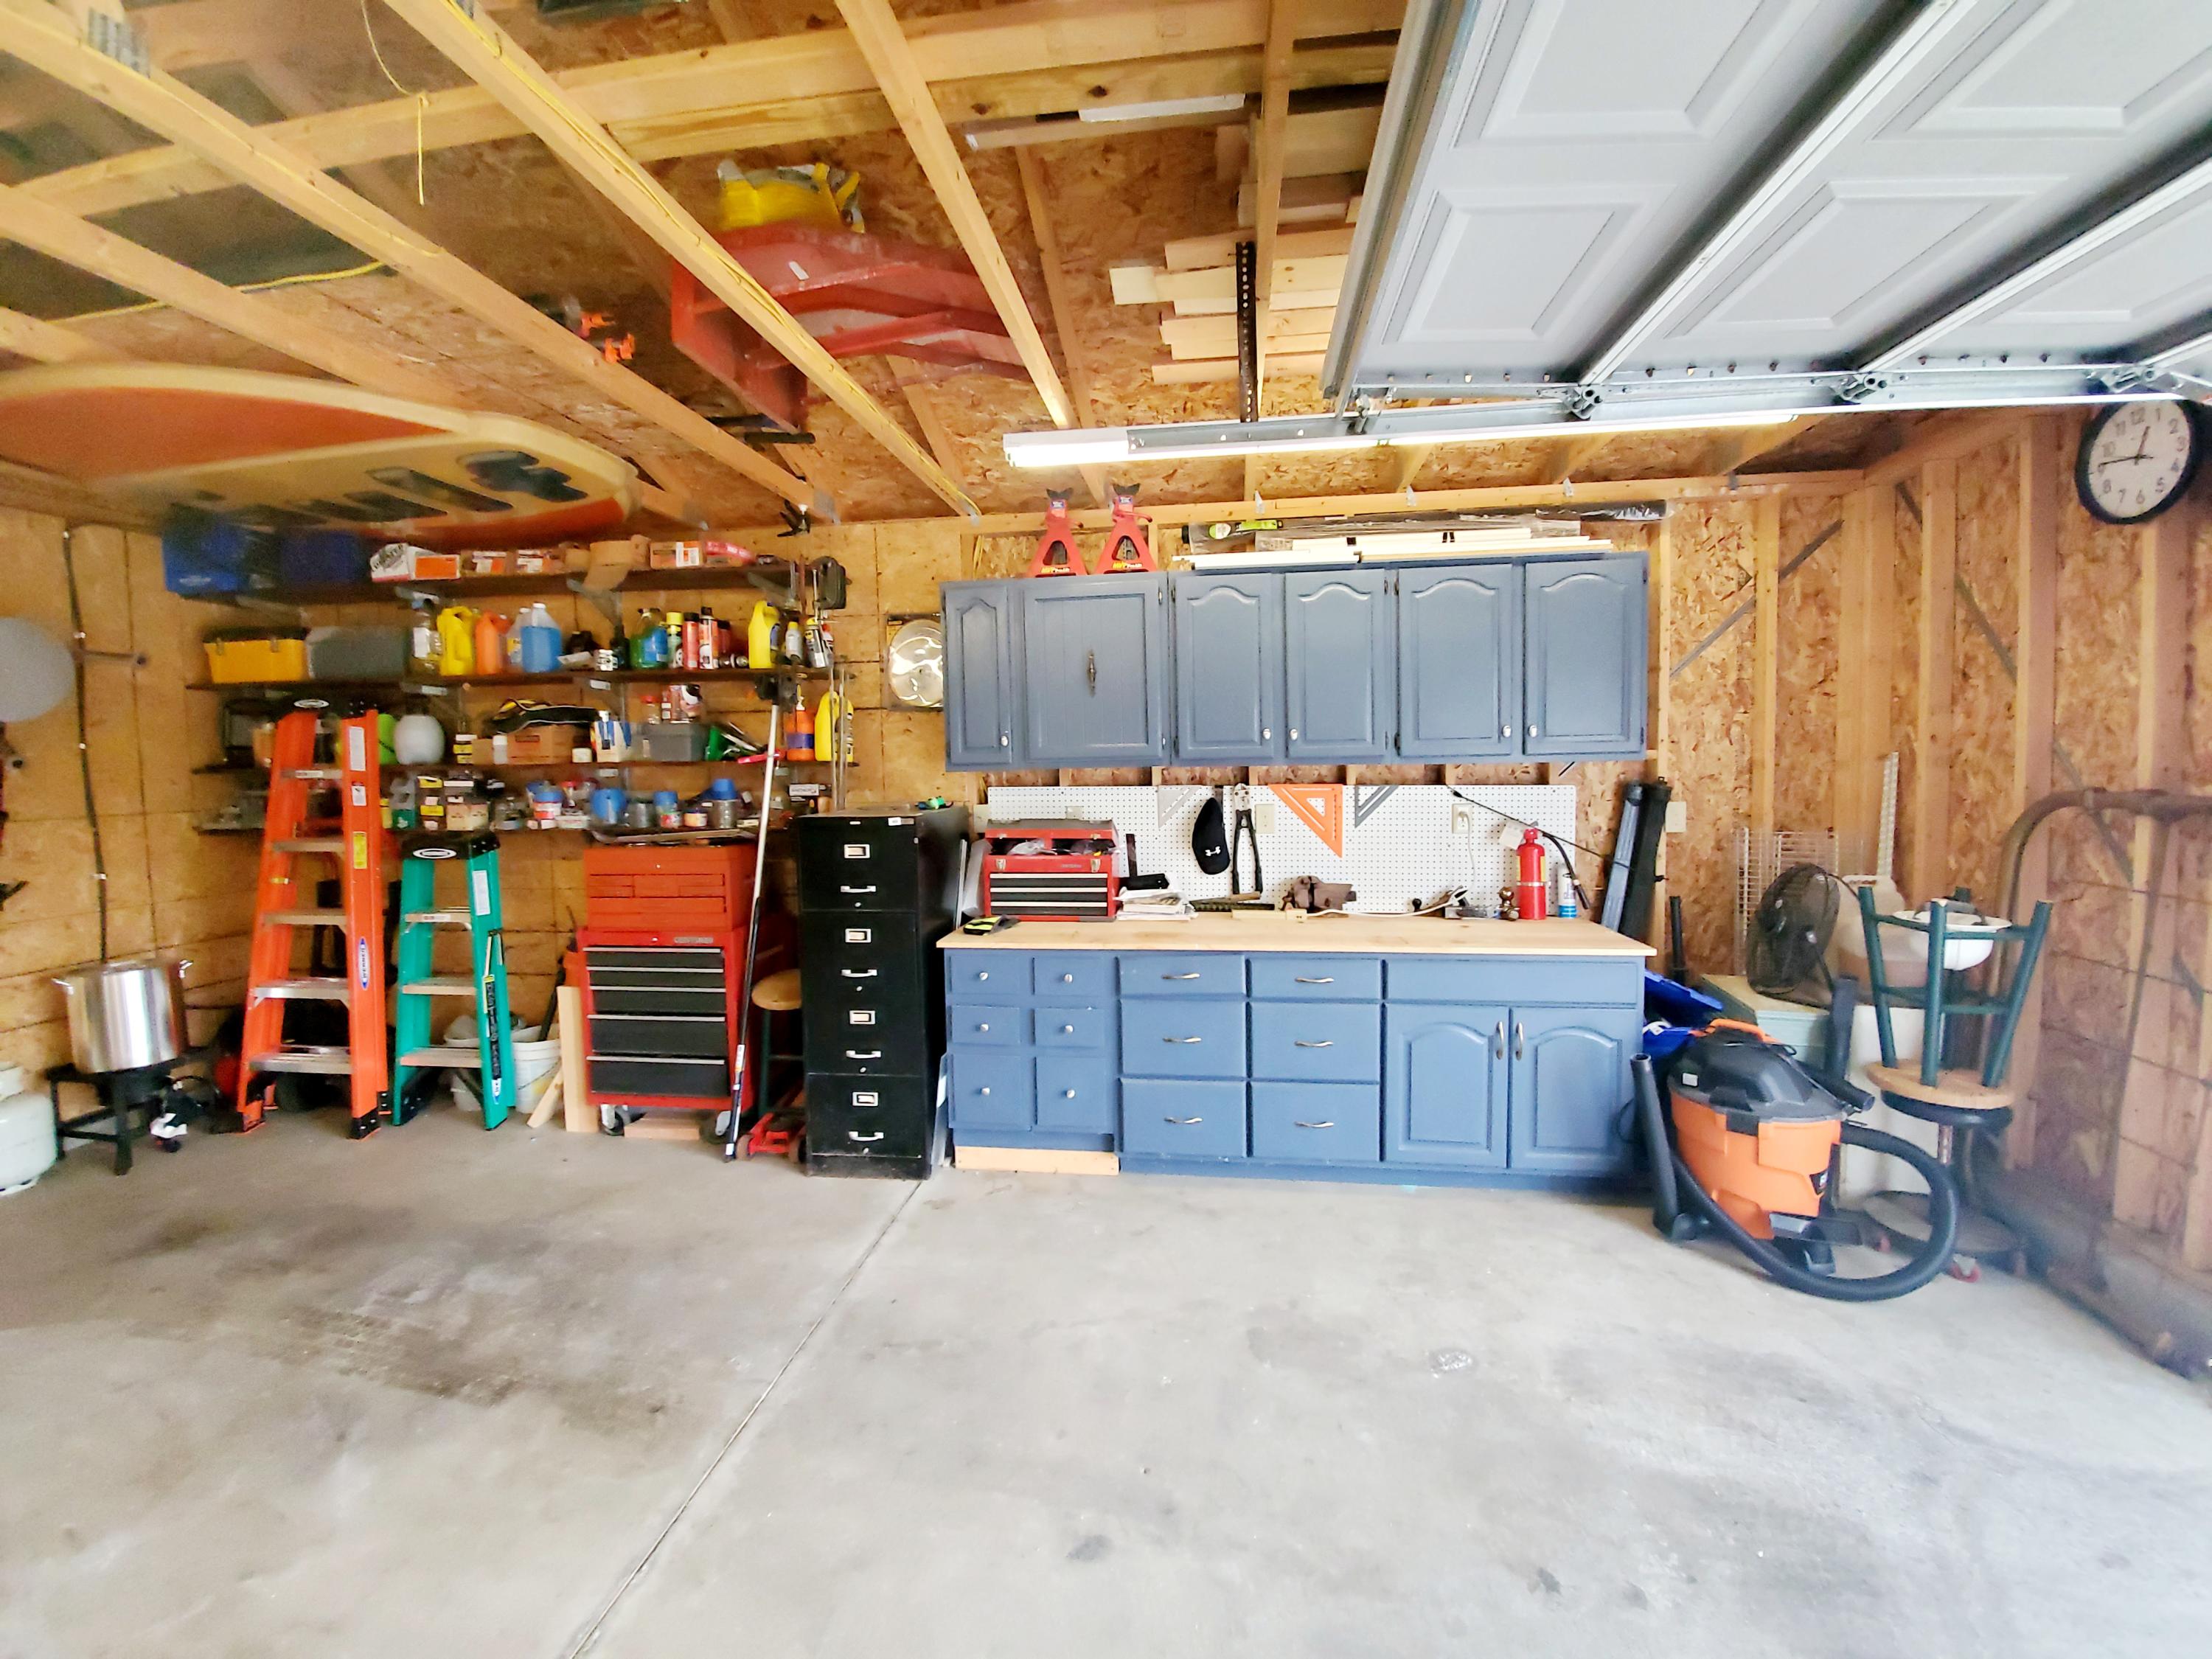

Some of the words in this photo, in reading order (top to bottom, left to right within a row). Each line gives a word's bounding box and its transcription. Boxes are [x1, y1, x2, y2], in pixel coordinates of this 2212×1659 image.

[2129, 407, 2145, 425] 12
[2154, 408, 2161, 421] 1
[2169, 418, 2179, 434] 2
[2177, 437, 2186, 452] 3
[2171, 457, 2180, 472] 4
[2102, 479, 2112, 494] 8
[2154, 477, 2164, 493] 5
[2119, 488, 2126, 503] 7
[2135, 490, 2146, 504] 6
